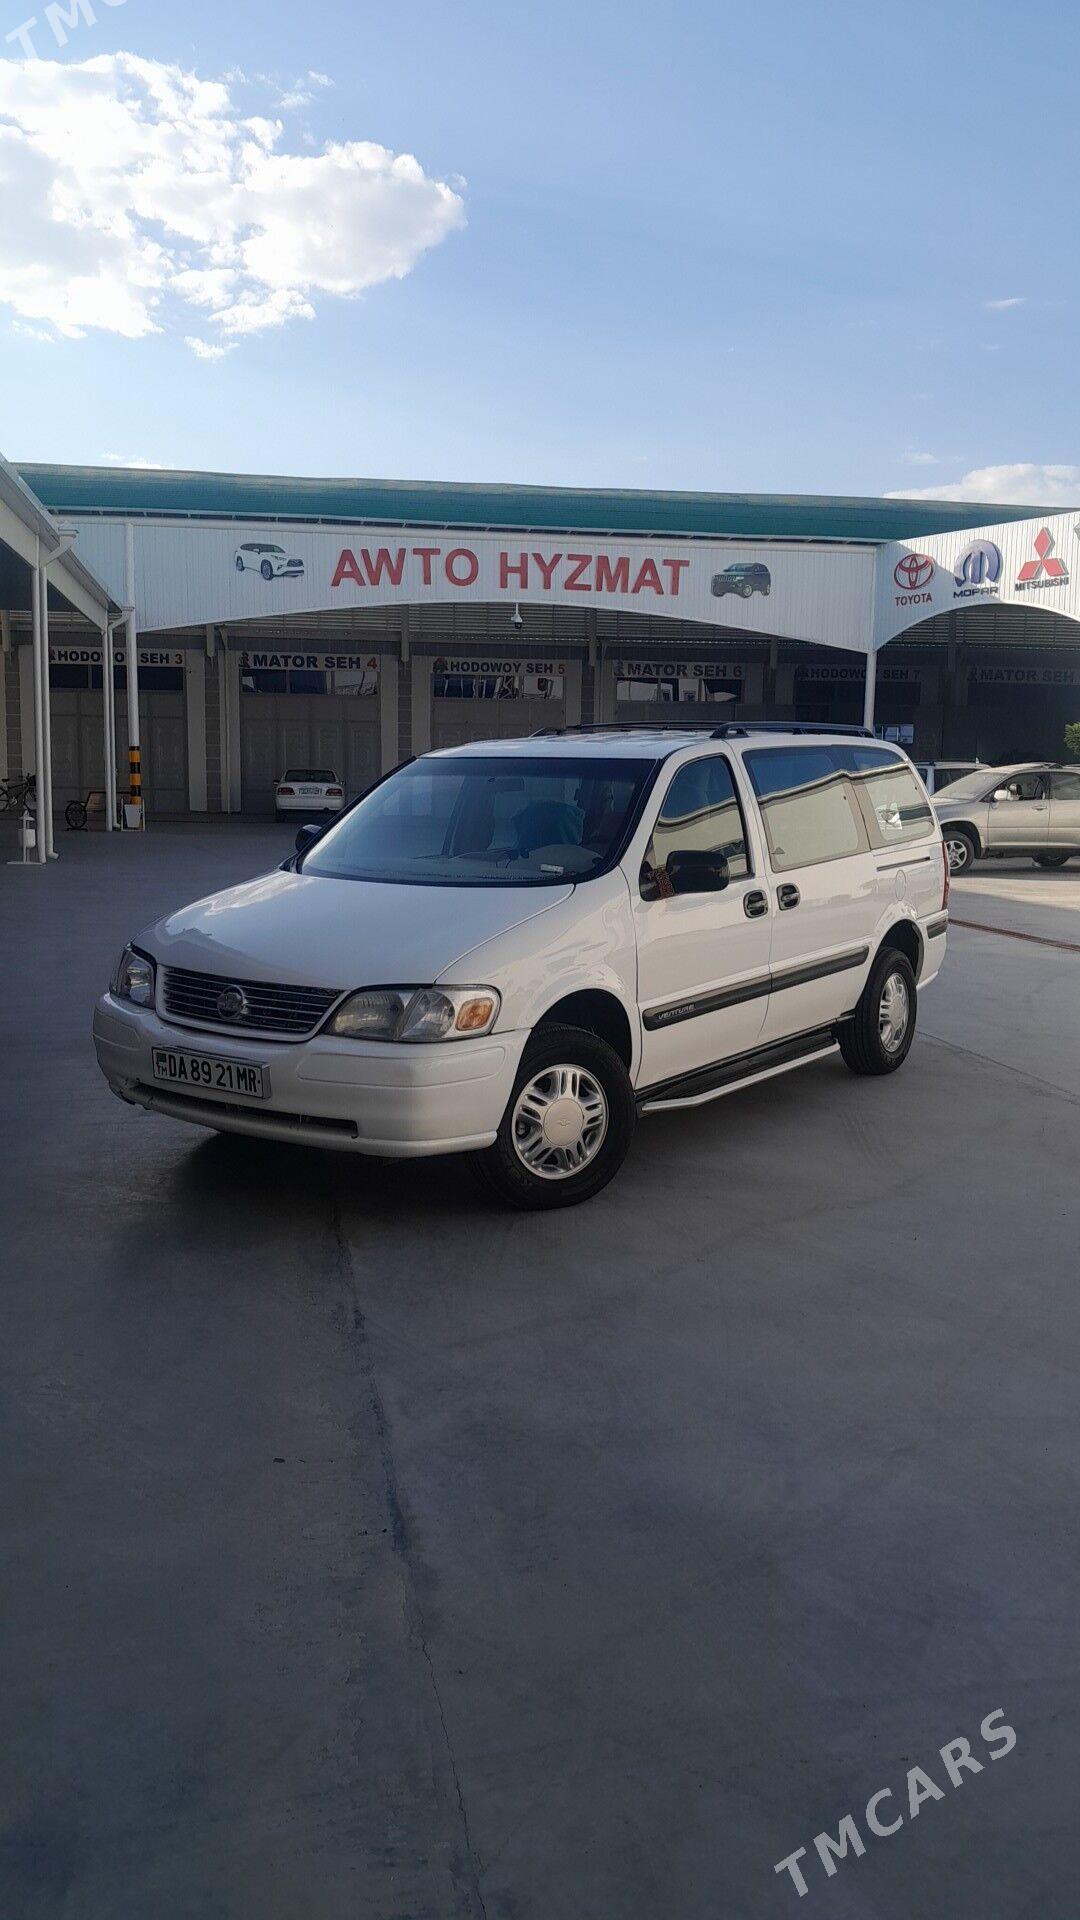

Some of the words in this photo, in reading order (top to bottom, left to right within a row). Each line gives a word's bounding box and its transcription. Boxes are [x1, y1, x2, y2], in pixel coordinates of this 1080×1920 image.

[330, 547, 480, 587] AWTO
[499, 551, 691, 596] HYZMAT
[1014, 576, 1070, 592] MITSUBISHI
[895, 592, 933, 607] TOYOTA
[953, 586, 999, 599] MOPAR
[58, 650, 127, 663] HODOO
[140, 652, 170, 665] SEH
[174, 653, 183, 665] 3
[253, 654, 318, 669] MATOR
[324, 656, 361, 669] SEH
[366, 657, 378, 669] 4
[450, 661, 521, 673] HODOWOY
[526, 662, 554, 674] SEH
[558, 664, 566, 675] 5
[627, 663, 688, 677] MATOR
[693, 664, 727, 677] SEH
[733, 664, 742, 678] 6
[883, 669, 909, 680] SEH
[981, 669, 1038, 681] MATOR
